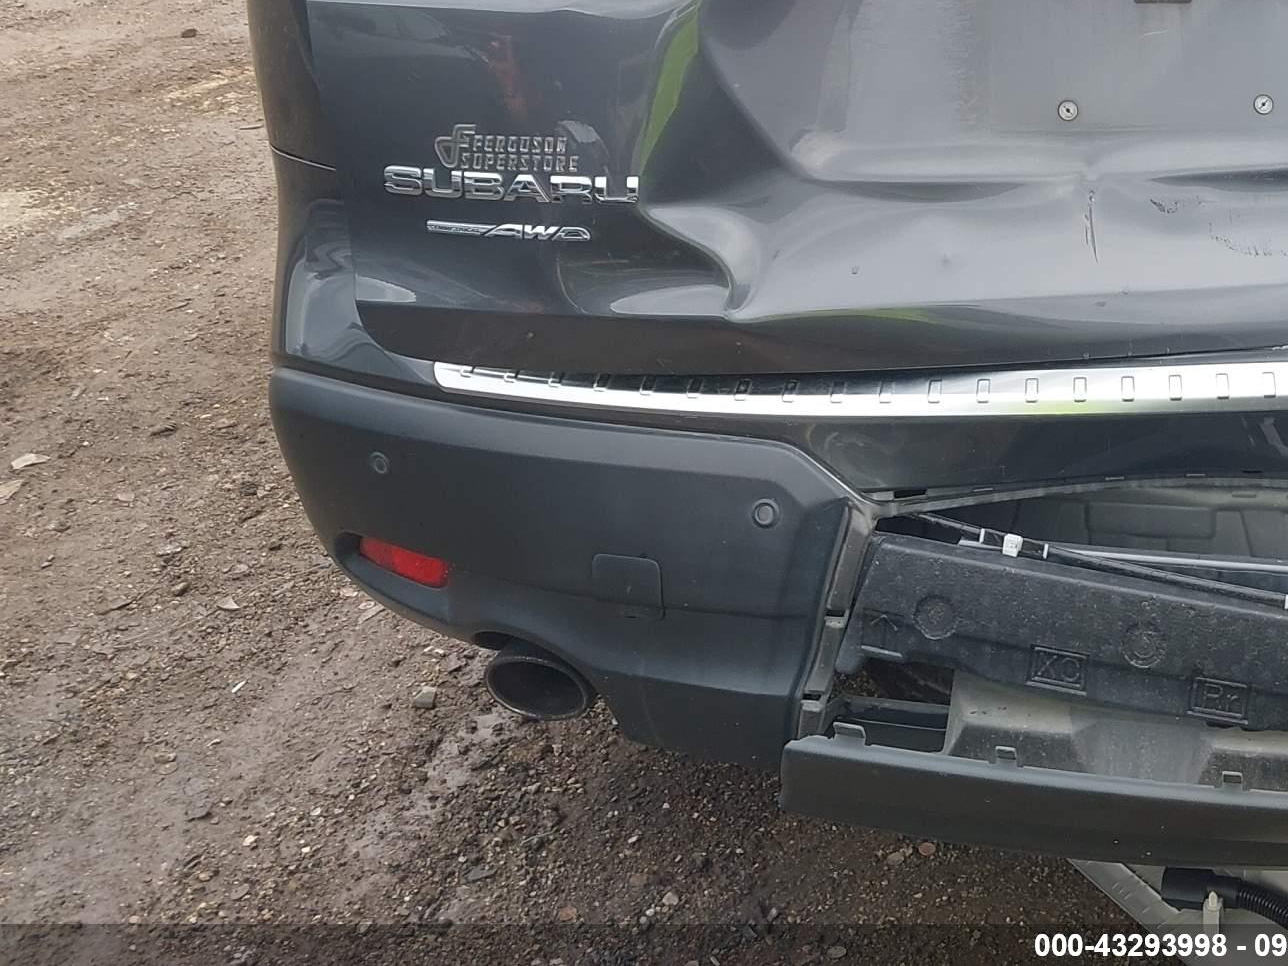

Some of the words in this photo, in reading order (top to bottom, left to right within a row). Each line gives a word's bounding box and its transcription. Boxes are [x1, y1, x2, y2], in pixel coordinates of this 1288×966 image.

[471, 134, 568, 155] FERGUSON
[460, 152, 580, 172] SUPERSTORE
[383, 165, 639, 203] SUBARU
[484, 222, 592, 242] AWD
